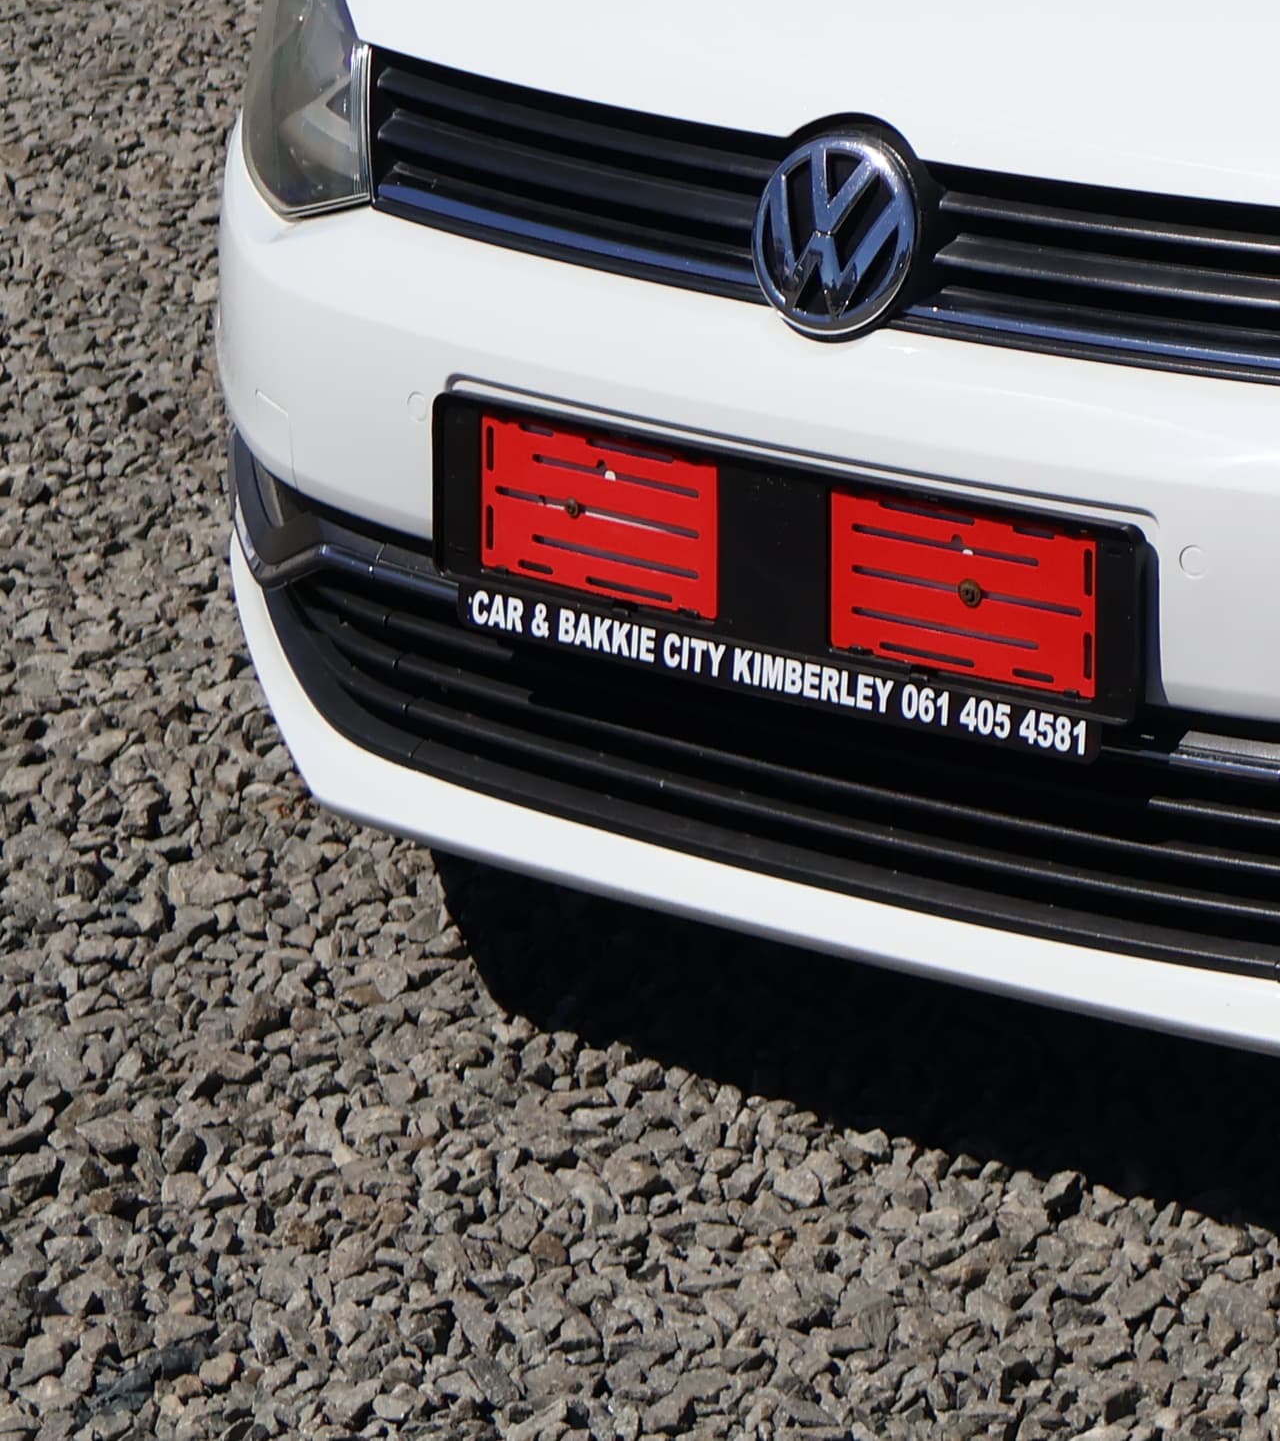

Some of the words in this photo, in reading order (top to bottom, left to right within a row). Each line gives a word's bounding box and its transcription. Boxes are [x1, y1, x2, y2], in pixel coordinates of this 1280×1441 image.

[472, 590, 523, 633] CAR
[531, 602, 550, 639] &
[557, 608, 657, 663] BAKKIE
[663, 633, 727, 677] CITY
[731, 647, 895, 714] KIMBERLEY
[901, 684, 950, 726] 061
[959, 697, 1012, 739] 405
[1018, 709, 1088, 756] 4581
